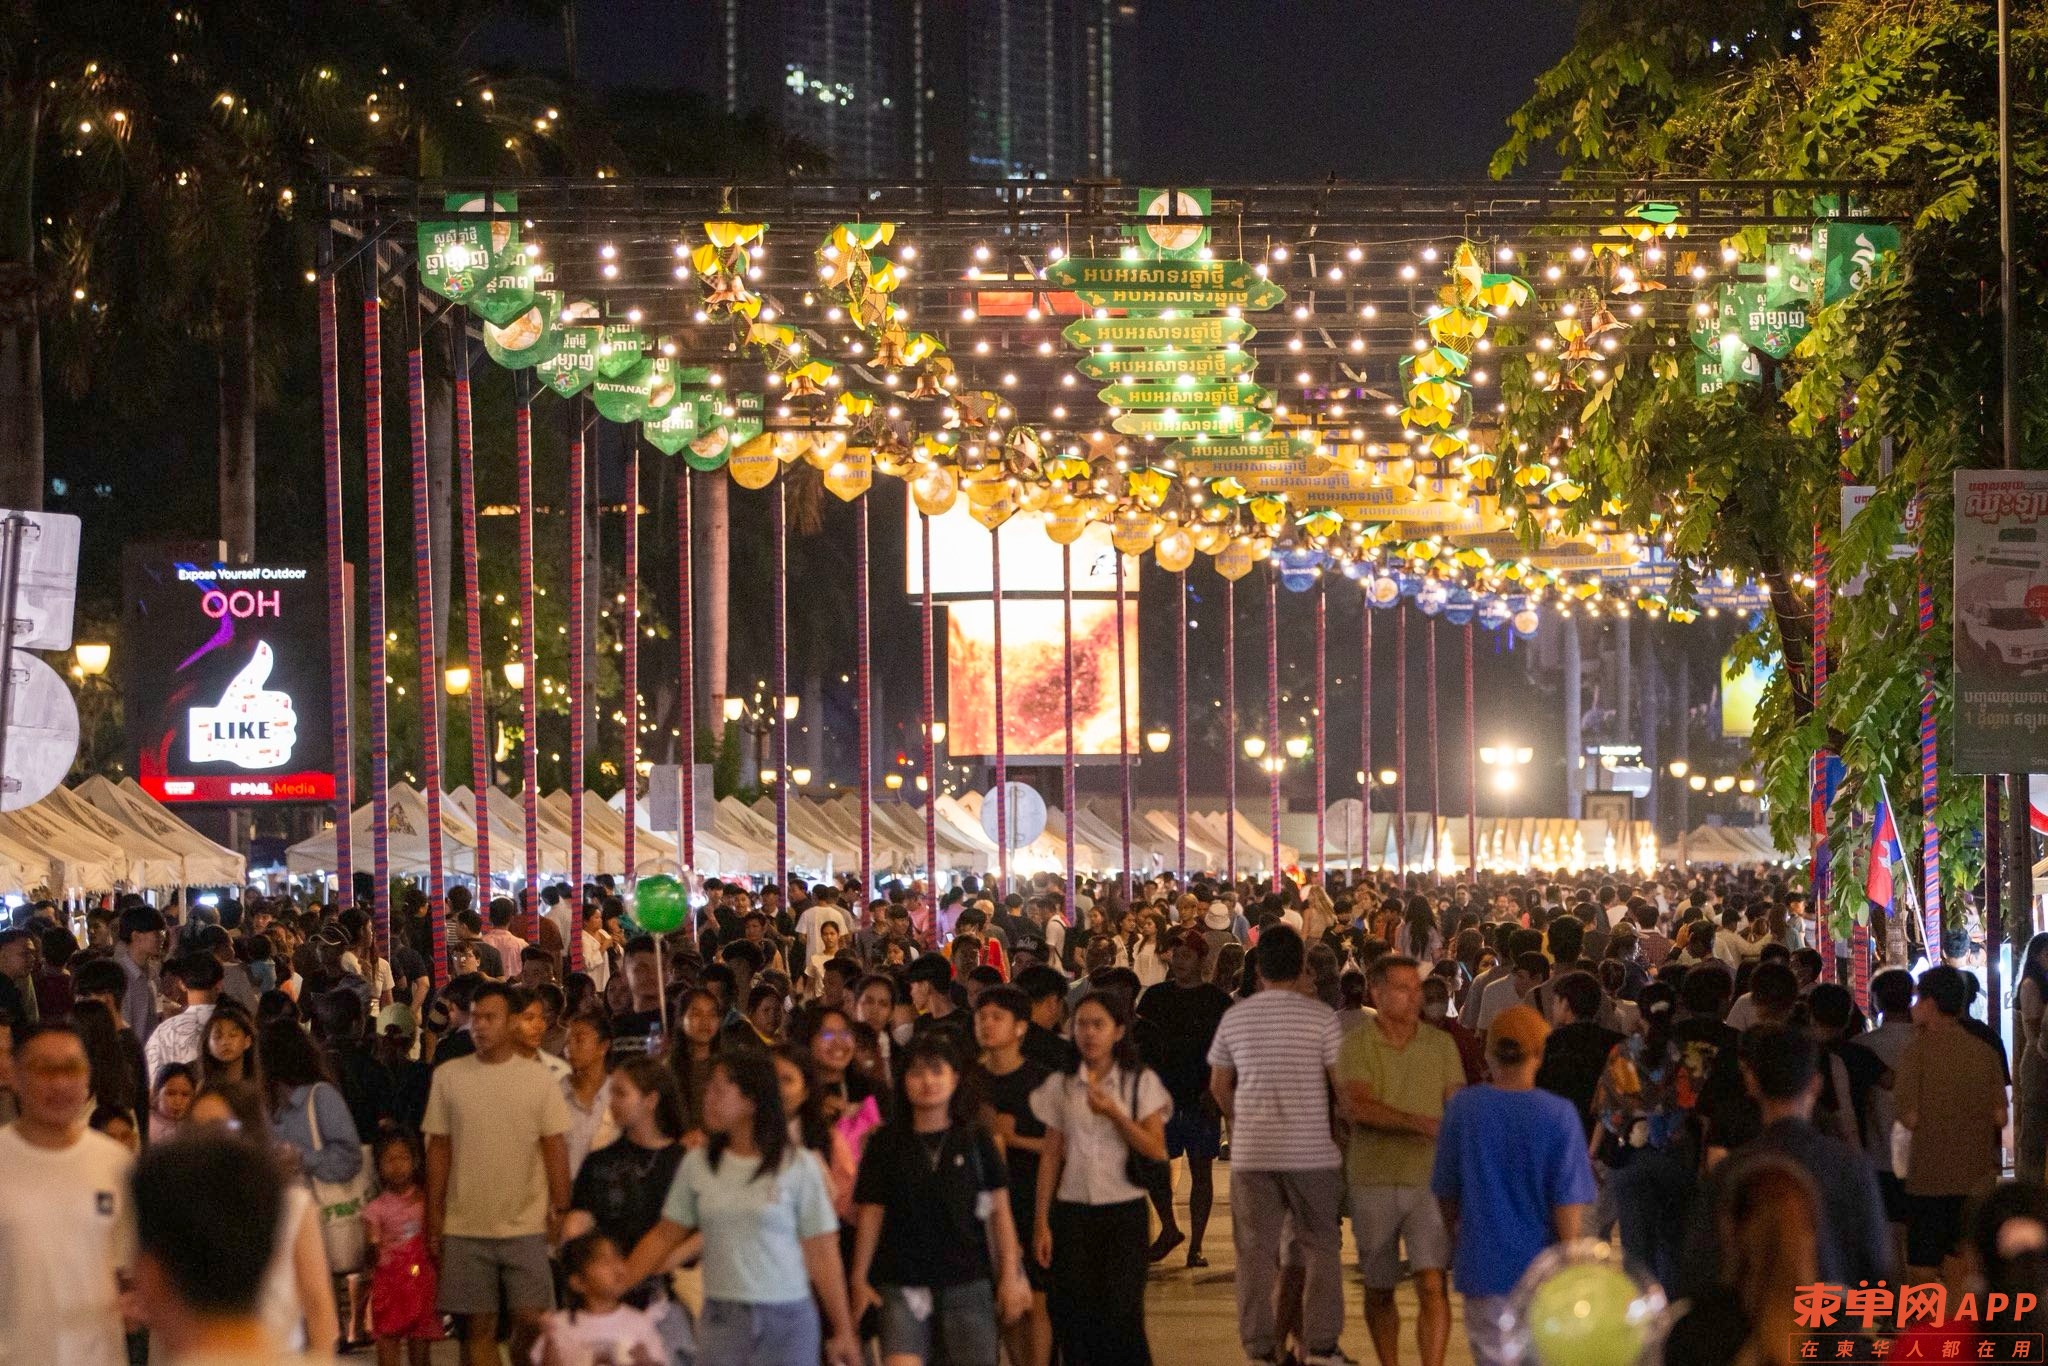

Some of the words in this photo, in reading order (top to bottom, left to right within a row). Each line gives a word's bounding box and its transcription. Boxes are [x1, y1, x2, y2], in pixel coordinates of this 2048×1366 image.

[1084, 264, 1224, 289] អបអរសាទរឆ្នាំថ្មី
[1098, 321, 1222, 344] អបអរសាទរឆ្នាំថ្មី
[596, 383, 650, 395] VATTANAC
[178, 569, 217, 582] Expose
[217, 568, 261, 580] Yourself
[261, 568, 307, 579] Outdoor
[202, 590, 280, 619] OOH
[214, 721, 270, 740] LIKE
[230, 782, 273, 796] PPML
[274, 783, 316, 795] Media
